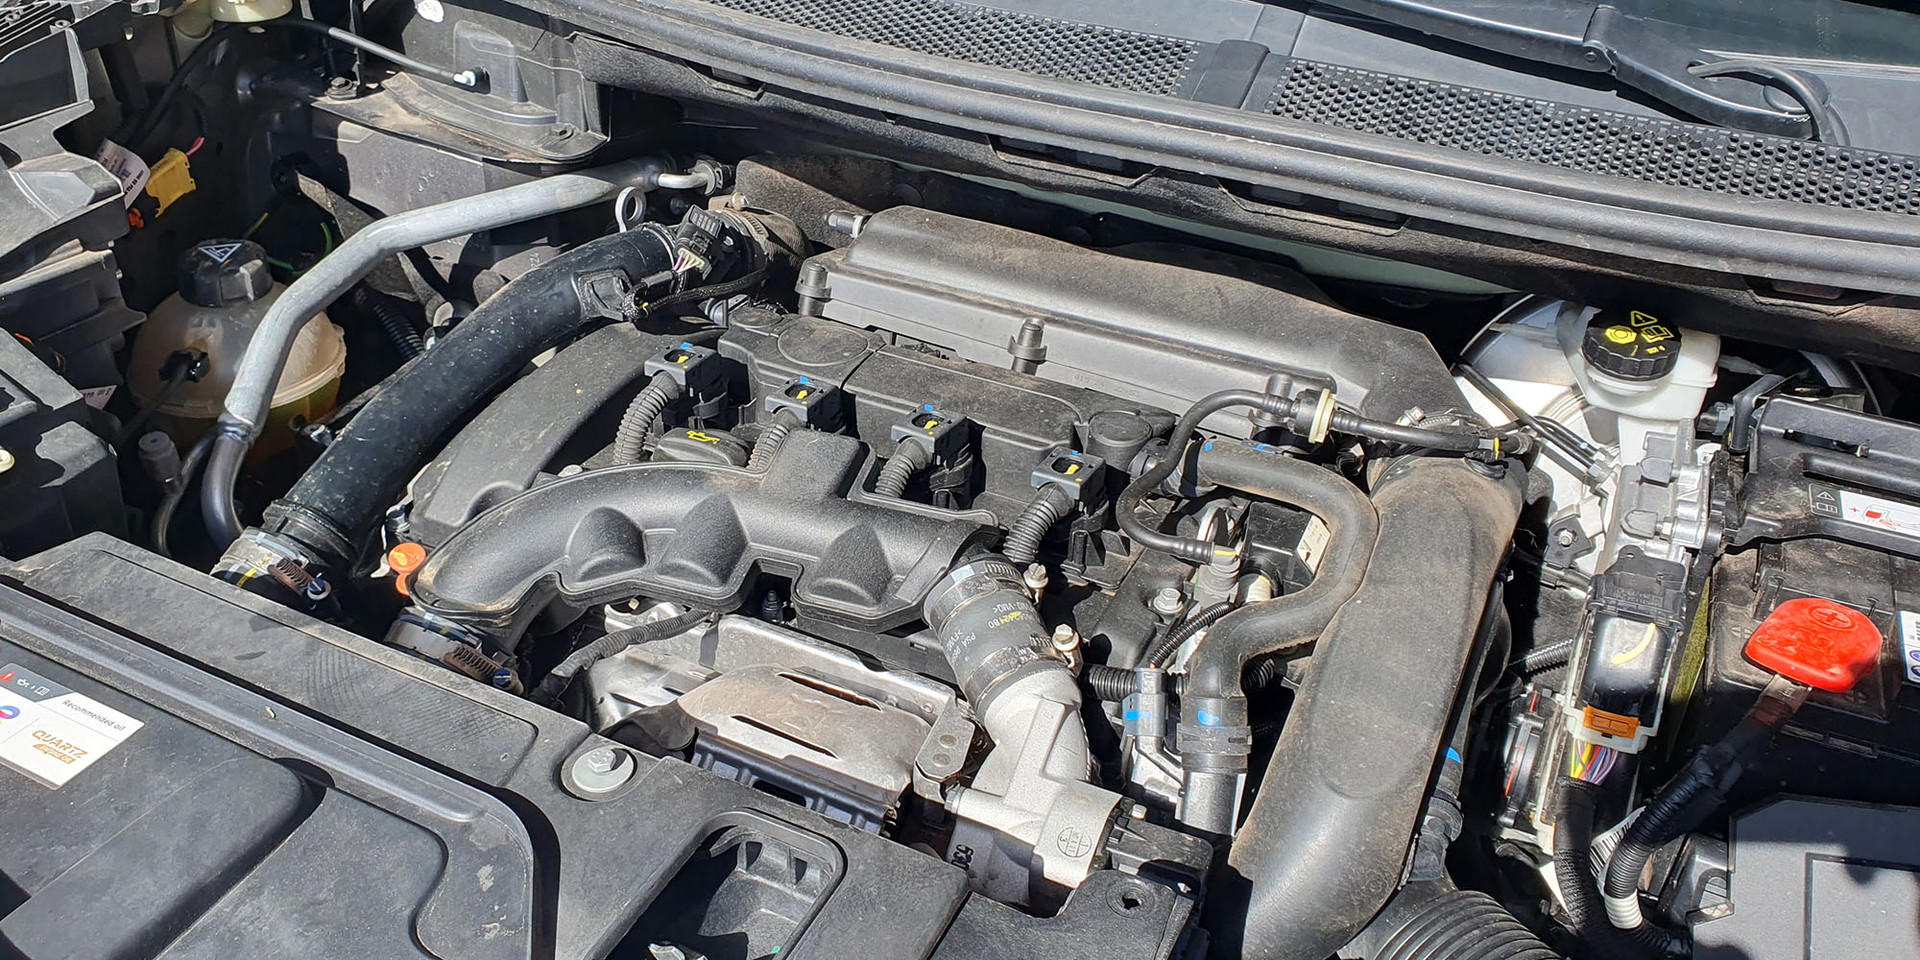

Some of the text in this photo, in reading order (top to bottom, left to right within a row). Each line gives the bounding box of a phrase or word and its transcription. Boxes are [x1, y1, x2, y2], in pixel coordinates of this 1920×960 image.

[961, 632, 976, 648] PSA
[62, 699, 126, 732] Recommended oil
[32, 729, 89, 759] QUARTZ
